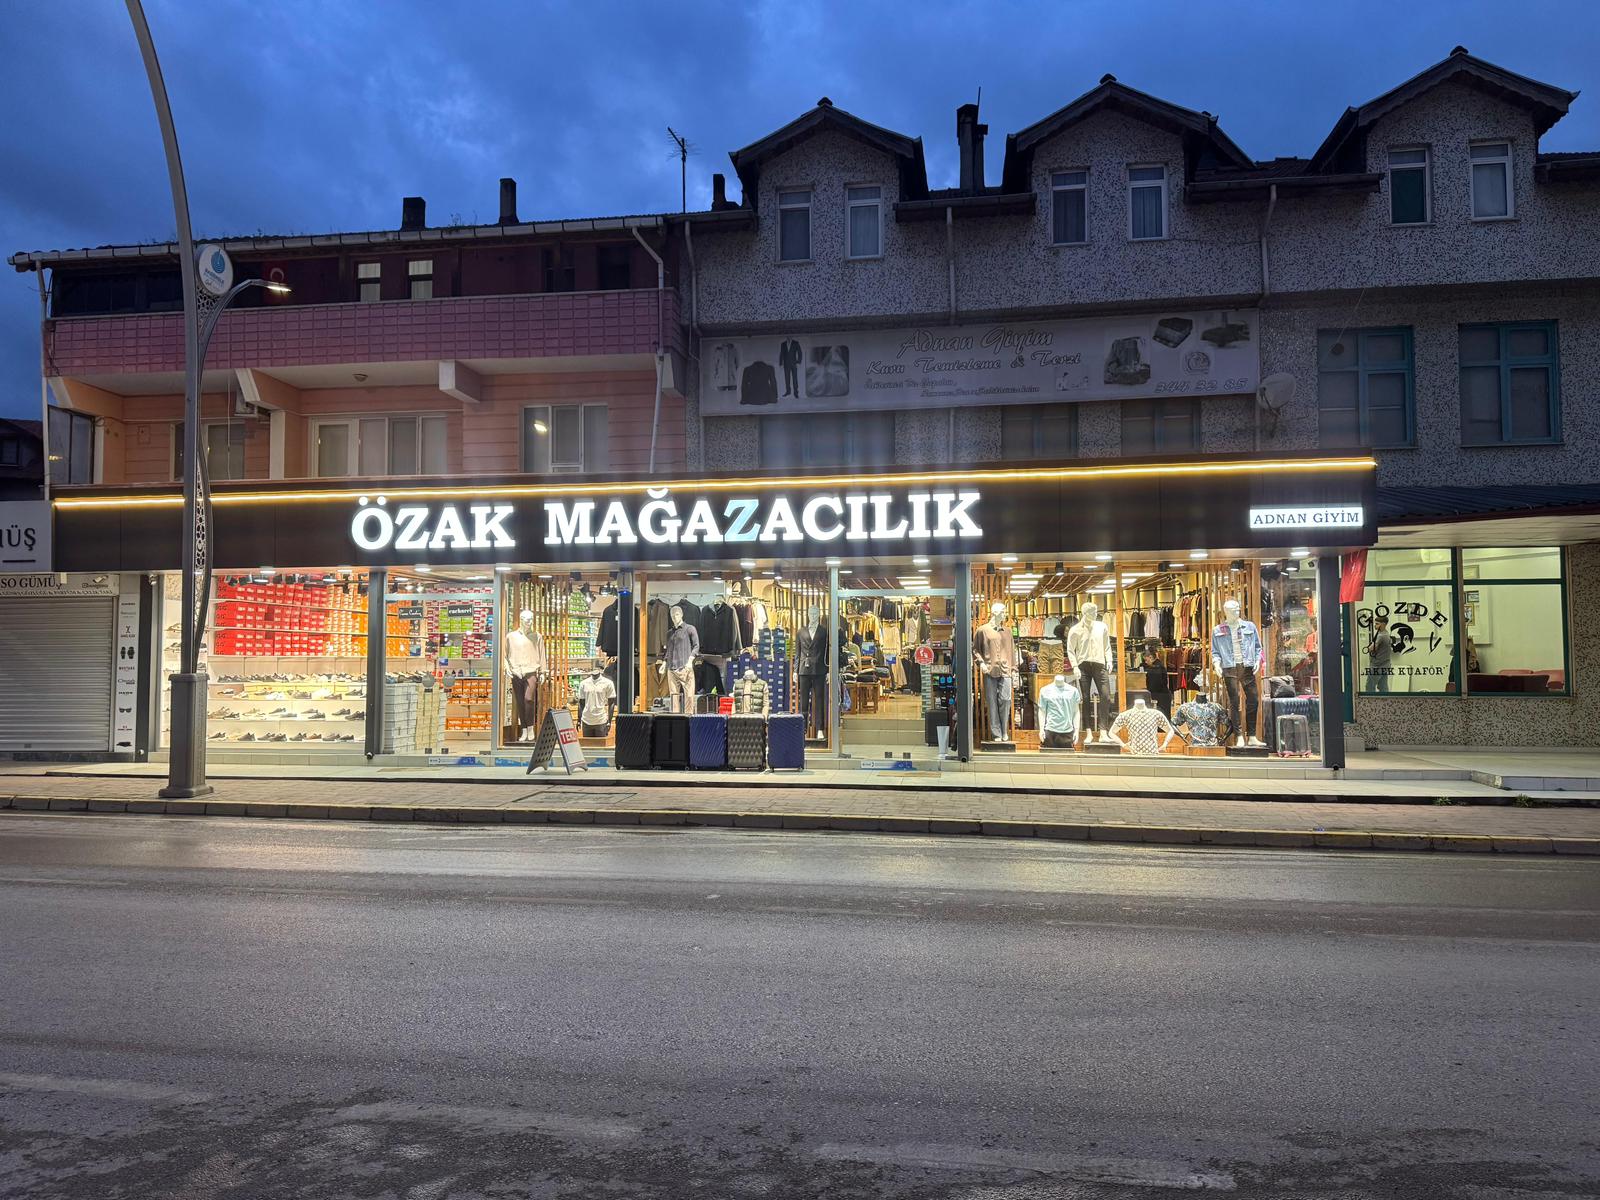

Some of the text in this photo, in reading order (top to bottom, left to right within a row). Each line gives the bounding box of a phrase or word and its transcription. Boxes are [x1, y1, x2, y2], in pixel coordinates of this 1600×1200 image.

[896, 326, 1054, 358] Adnan Giyim
[351, 487, 983, 551] ÖZAK MAĞAZACILIK
[1253, 510, 1359, 525] ADNAN GİYİM
[1357, 601, 1448, 629] GÖZDE
